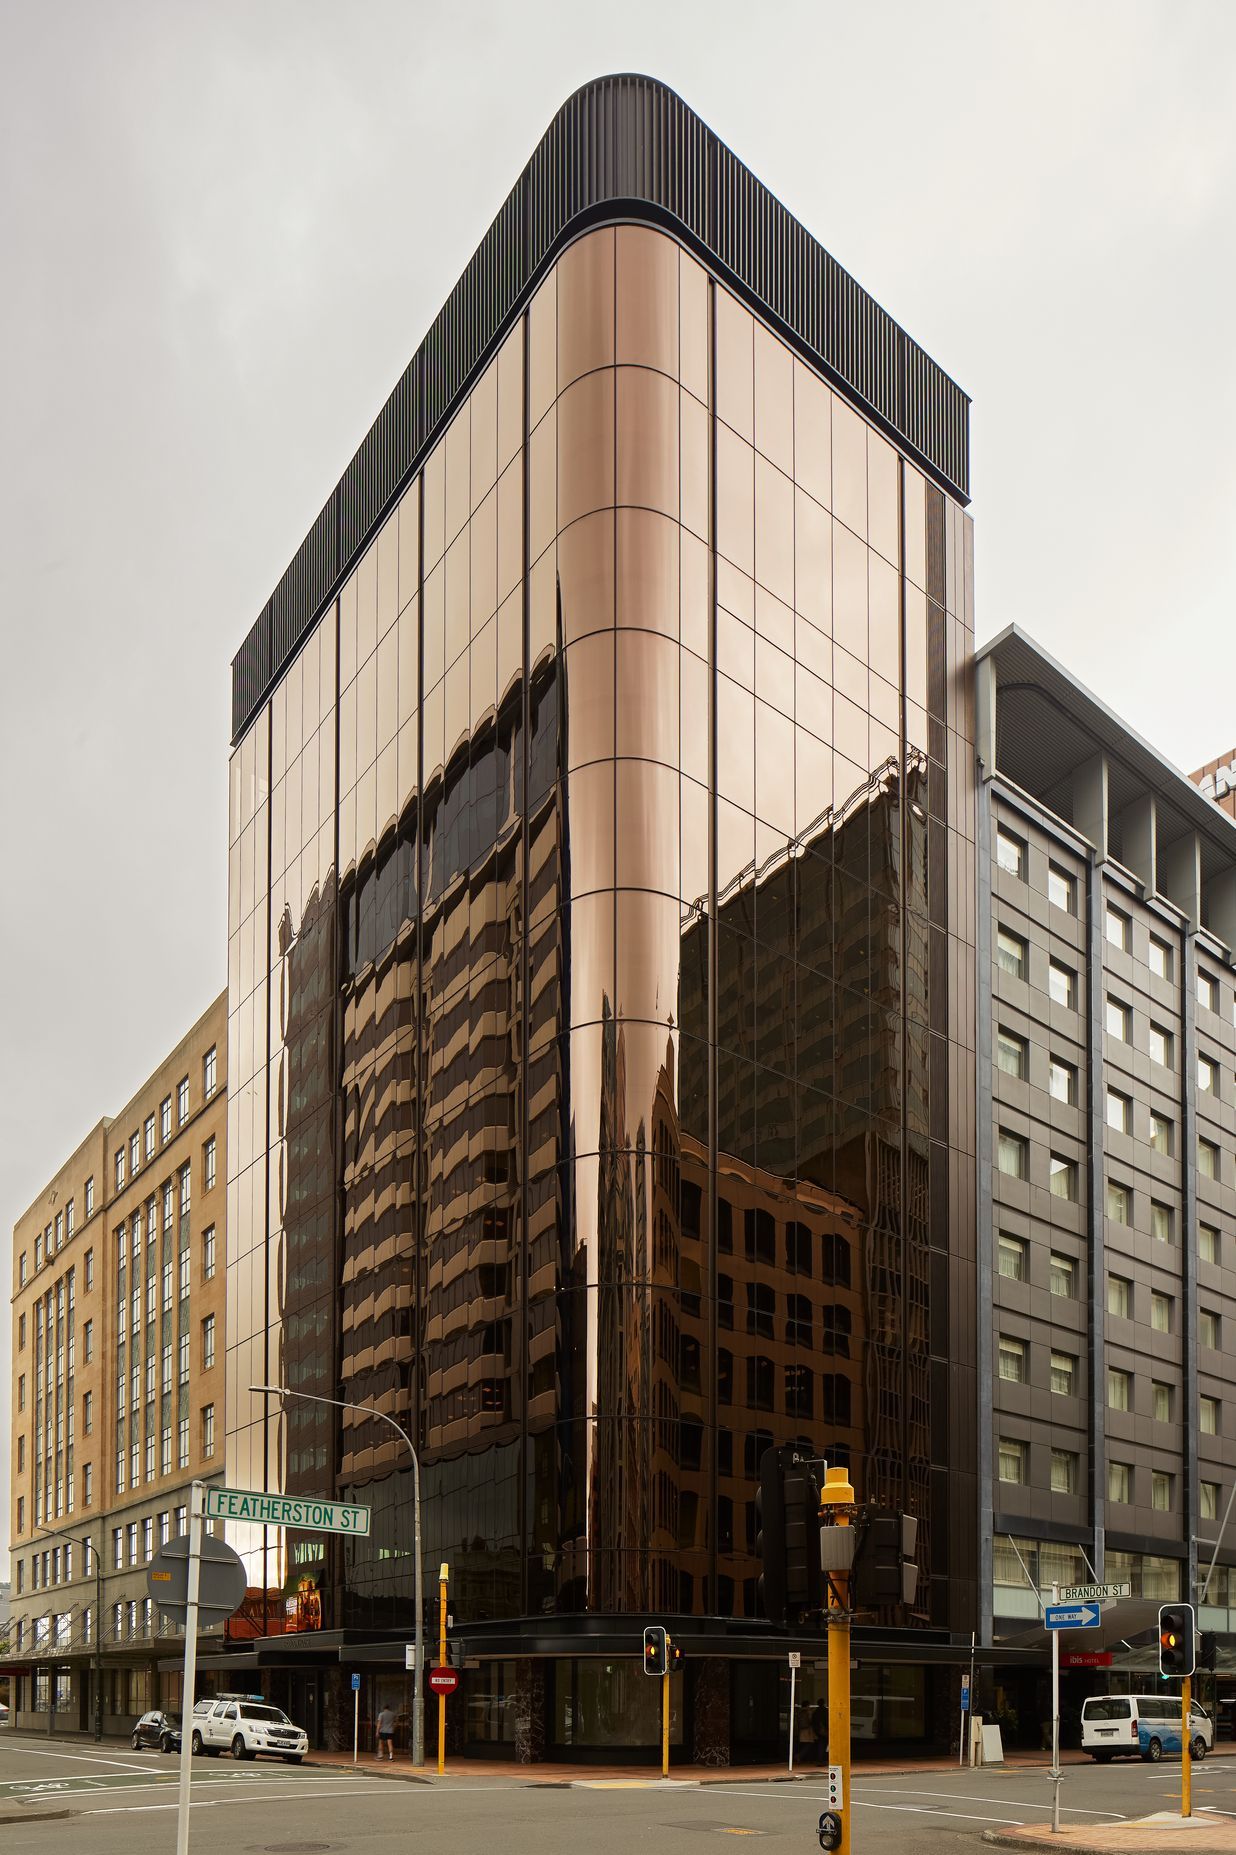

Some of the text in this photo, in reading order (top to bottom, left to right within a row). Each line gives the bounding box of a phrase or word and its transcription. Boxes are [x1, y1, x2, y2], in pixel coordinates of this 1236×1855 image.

[217, 1493, 360, 1529] FEATHERSTON ST
[1065, 1584, 1124, 1598] BRANDON ST
[1070, 1656, 1083, 1664] ibis
